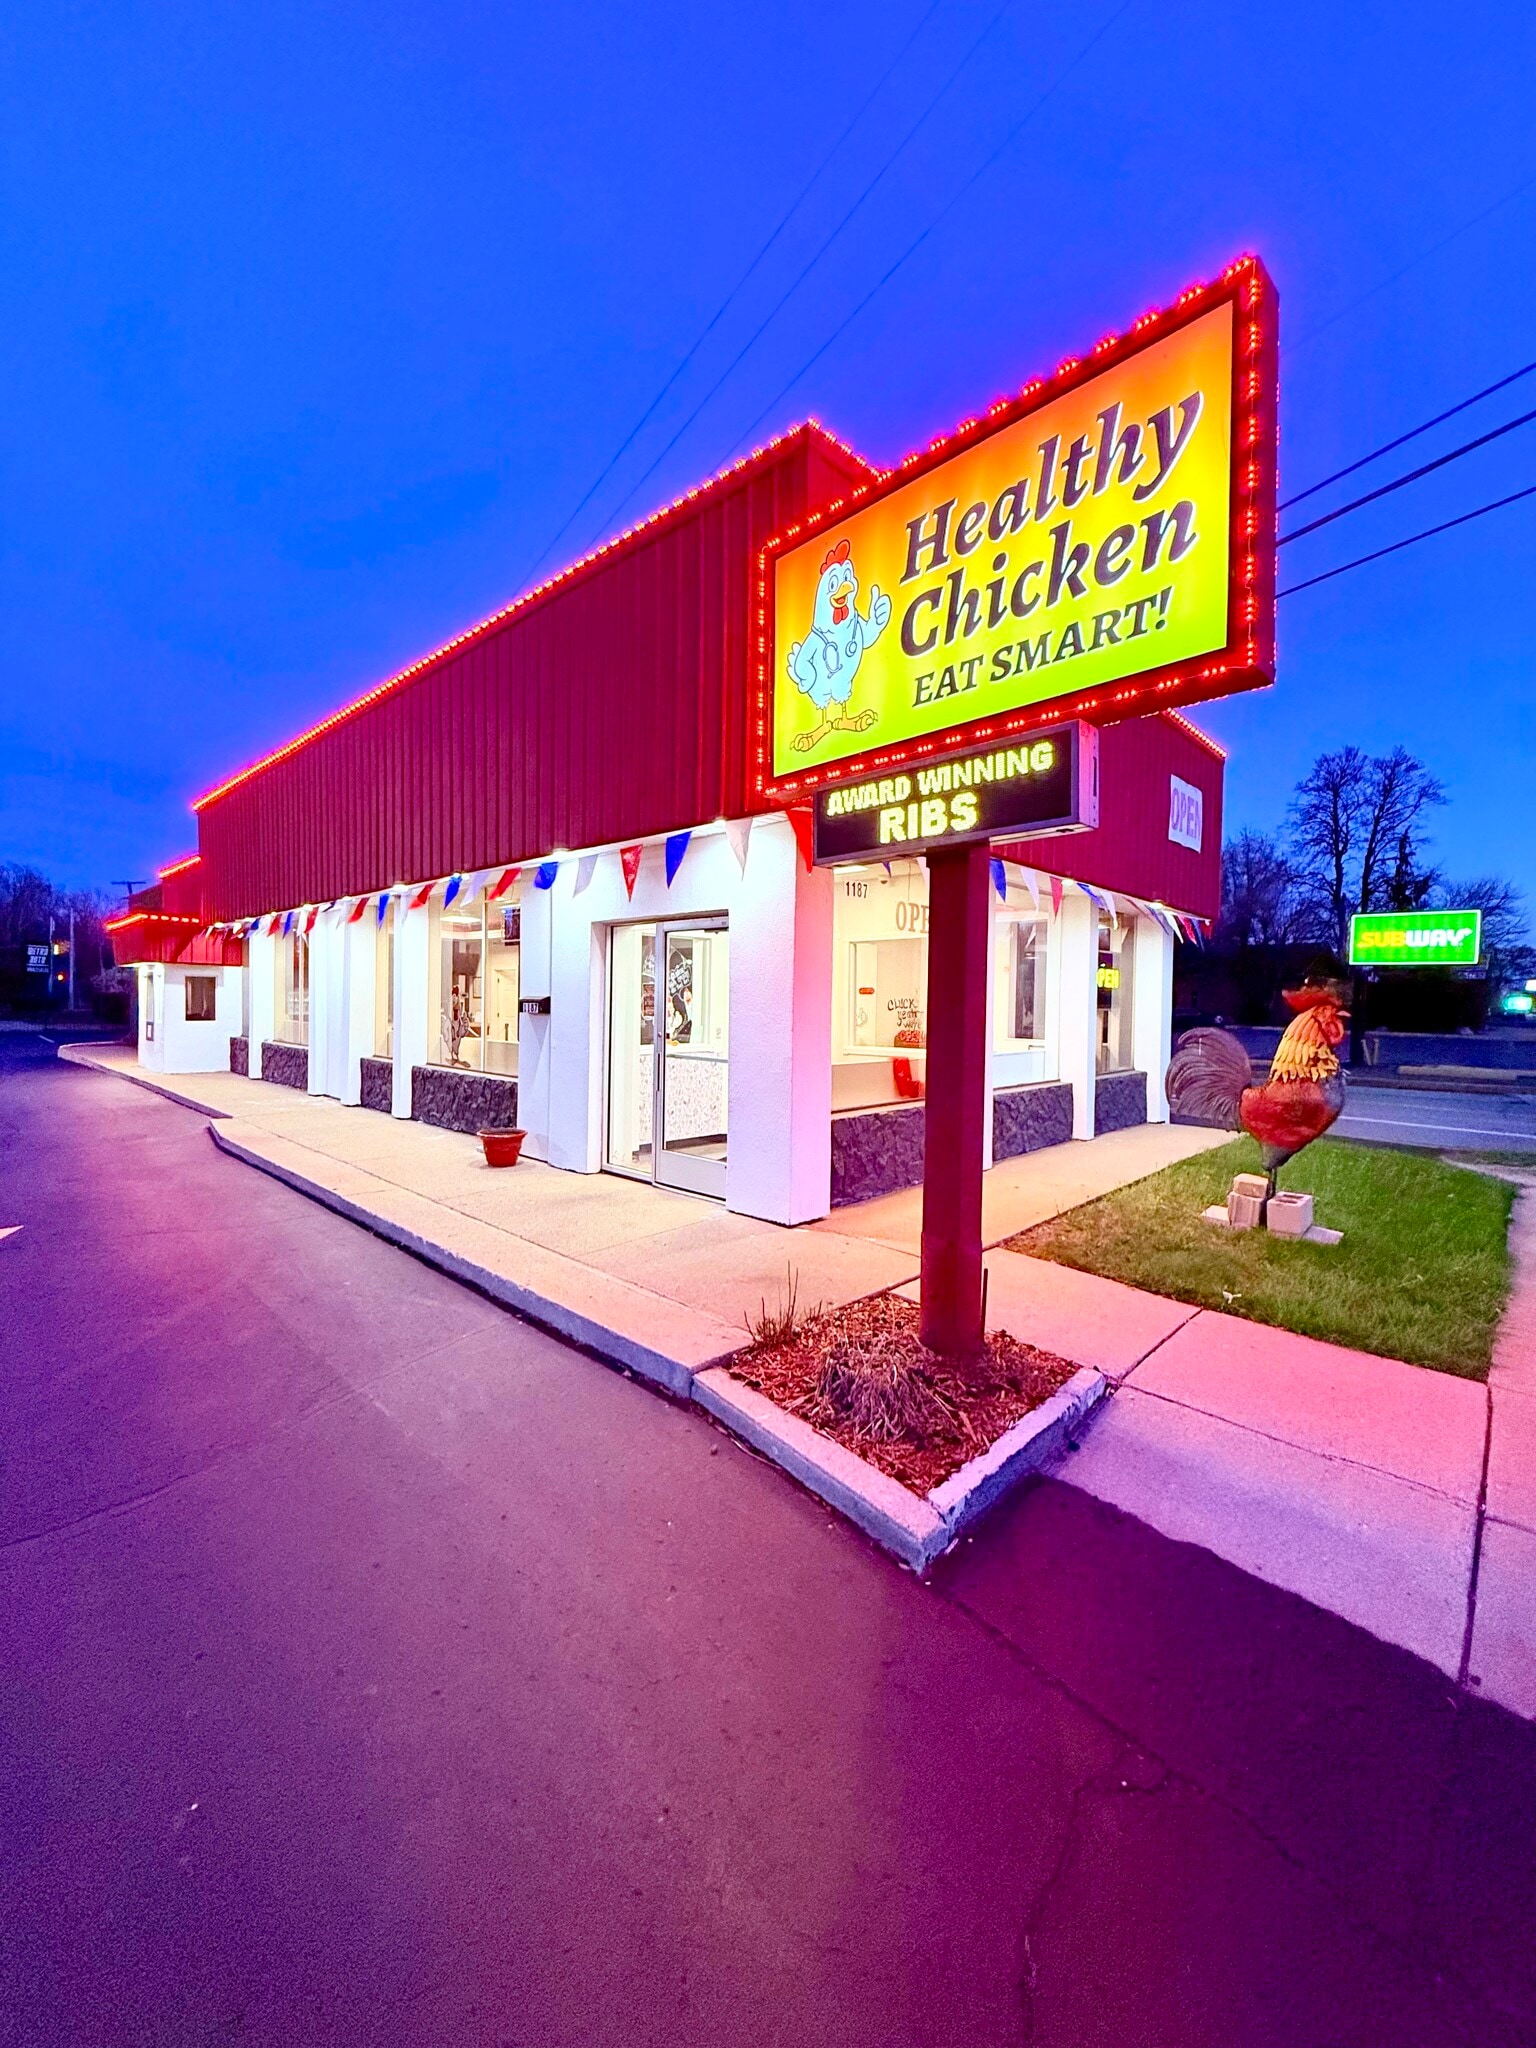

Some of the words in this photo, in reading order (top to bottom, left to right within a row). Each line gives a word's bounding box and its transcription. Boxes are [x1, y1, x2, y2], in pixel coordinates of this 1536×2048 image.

[900, 391, 1203, 584] Healthy
[901, 500, 1198, 657] Chicken
[912, 654, 984, 708] EAT
[990, 586, 1173, 682] SMART!
[826, 775, 912, 817] AWARD
[916, 741, 1055, 796] WINNING
[878, 791, 979, 844] RIBS
[1171, 787, 1201, 839] OPEN
[845, 881, 868, 899] 1187
[895, 900, 930, 934] OPE
[1357, 927, 1473, 948] SUBWAY
